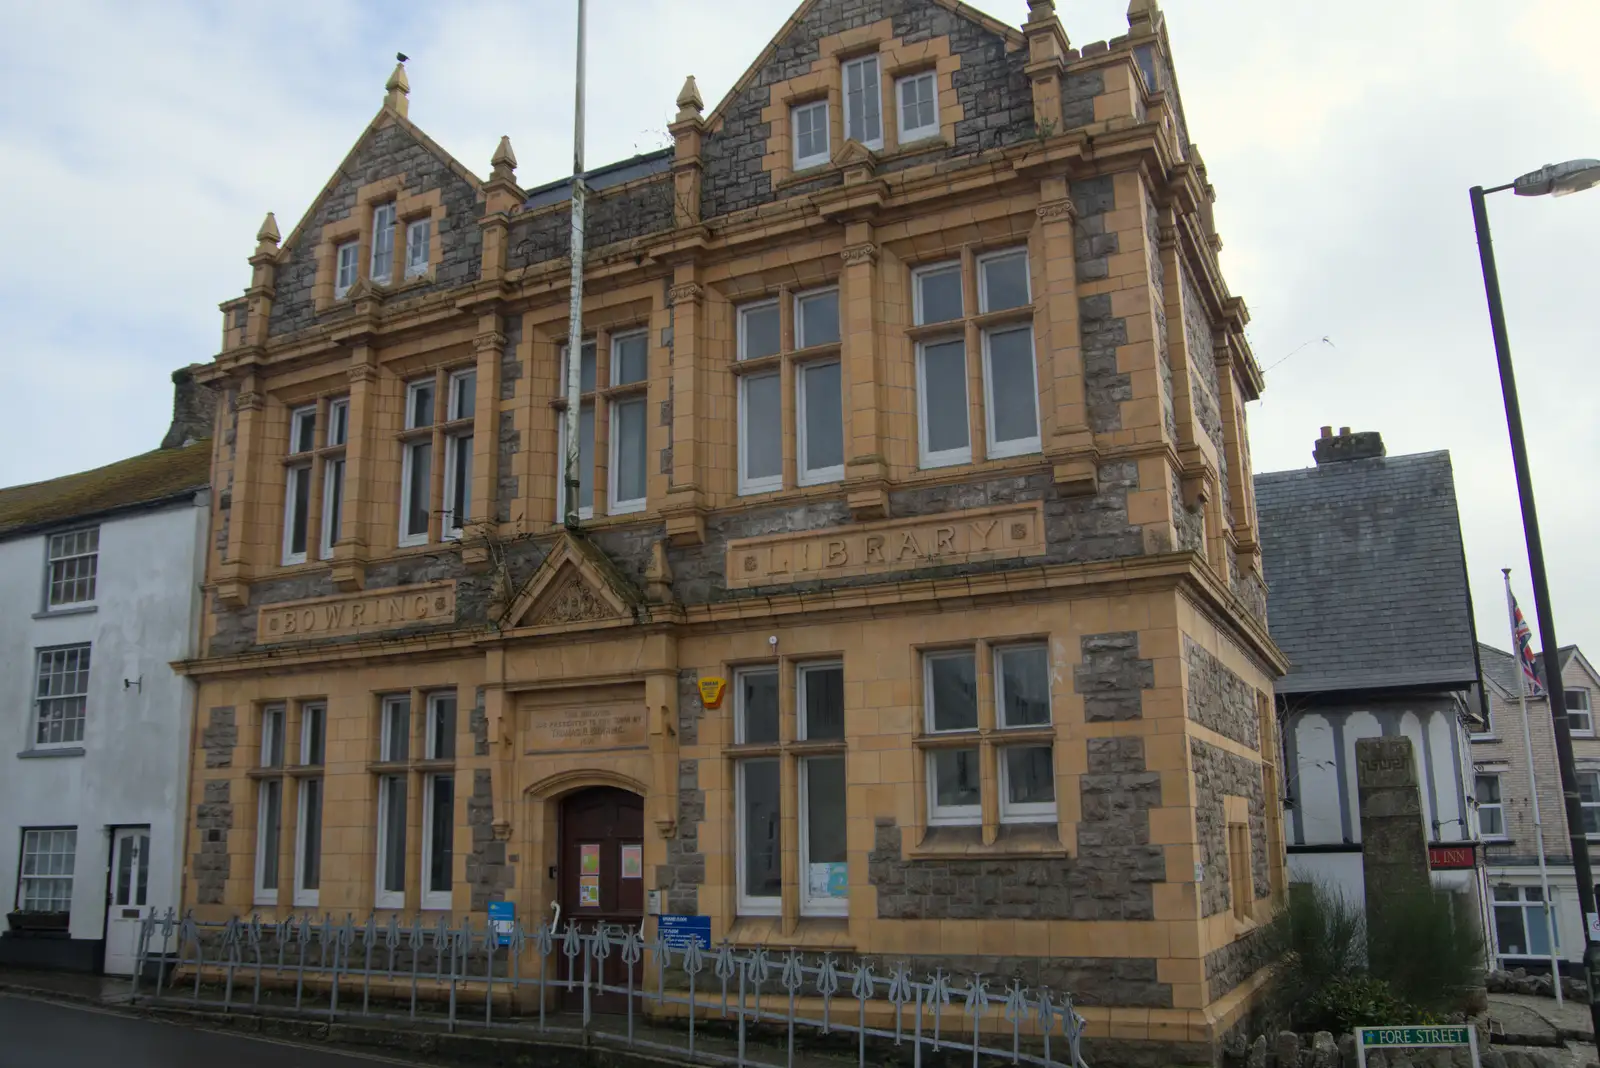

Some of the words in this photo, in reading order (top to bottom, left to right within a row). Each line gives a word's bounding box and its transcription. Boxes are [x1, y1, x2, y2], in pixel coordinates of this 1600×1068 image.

[767, 520, 998, 575] LIBRARY
[283, 594, 428, 634] BOWRING
[1443, 849, 1465, 863] INN
[1379, 1029, 1412, 1044] FORE
[1416, 1028, 1464, 1043] STREET
